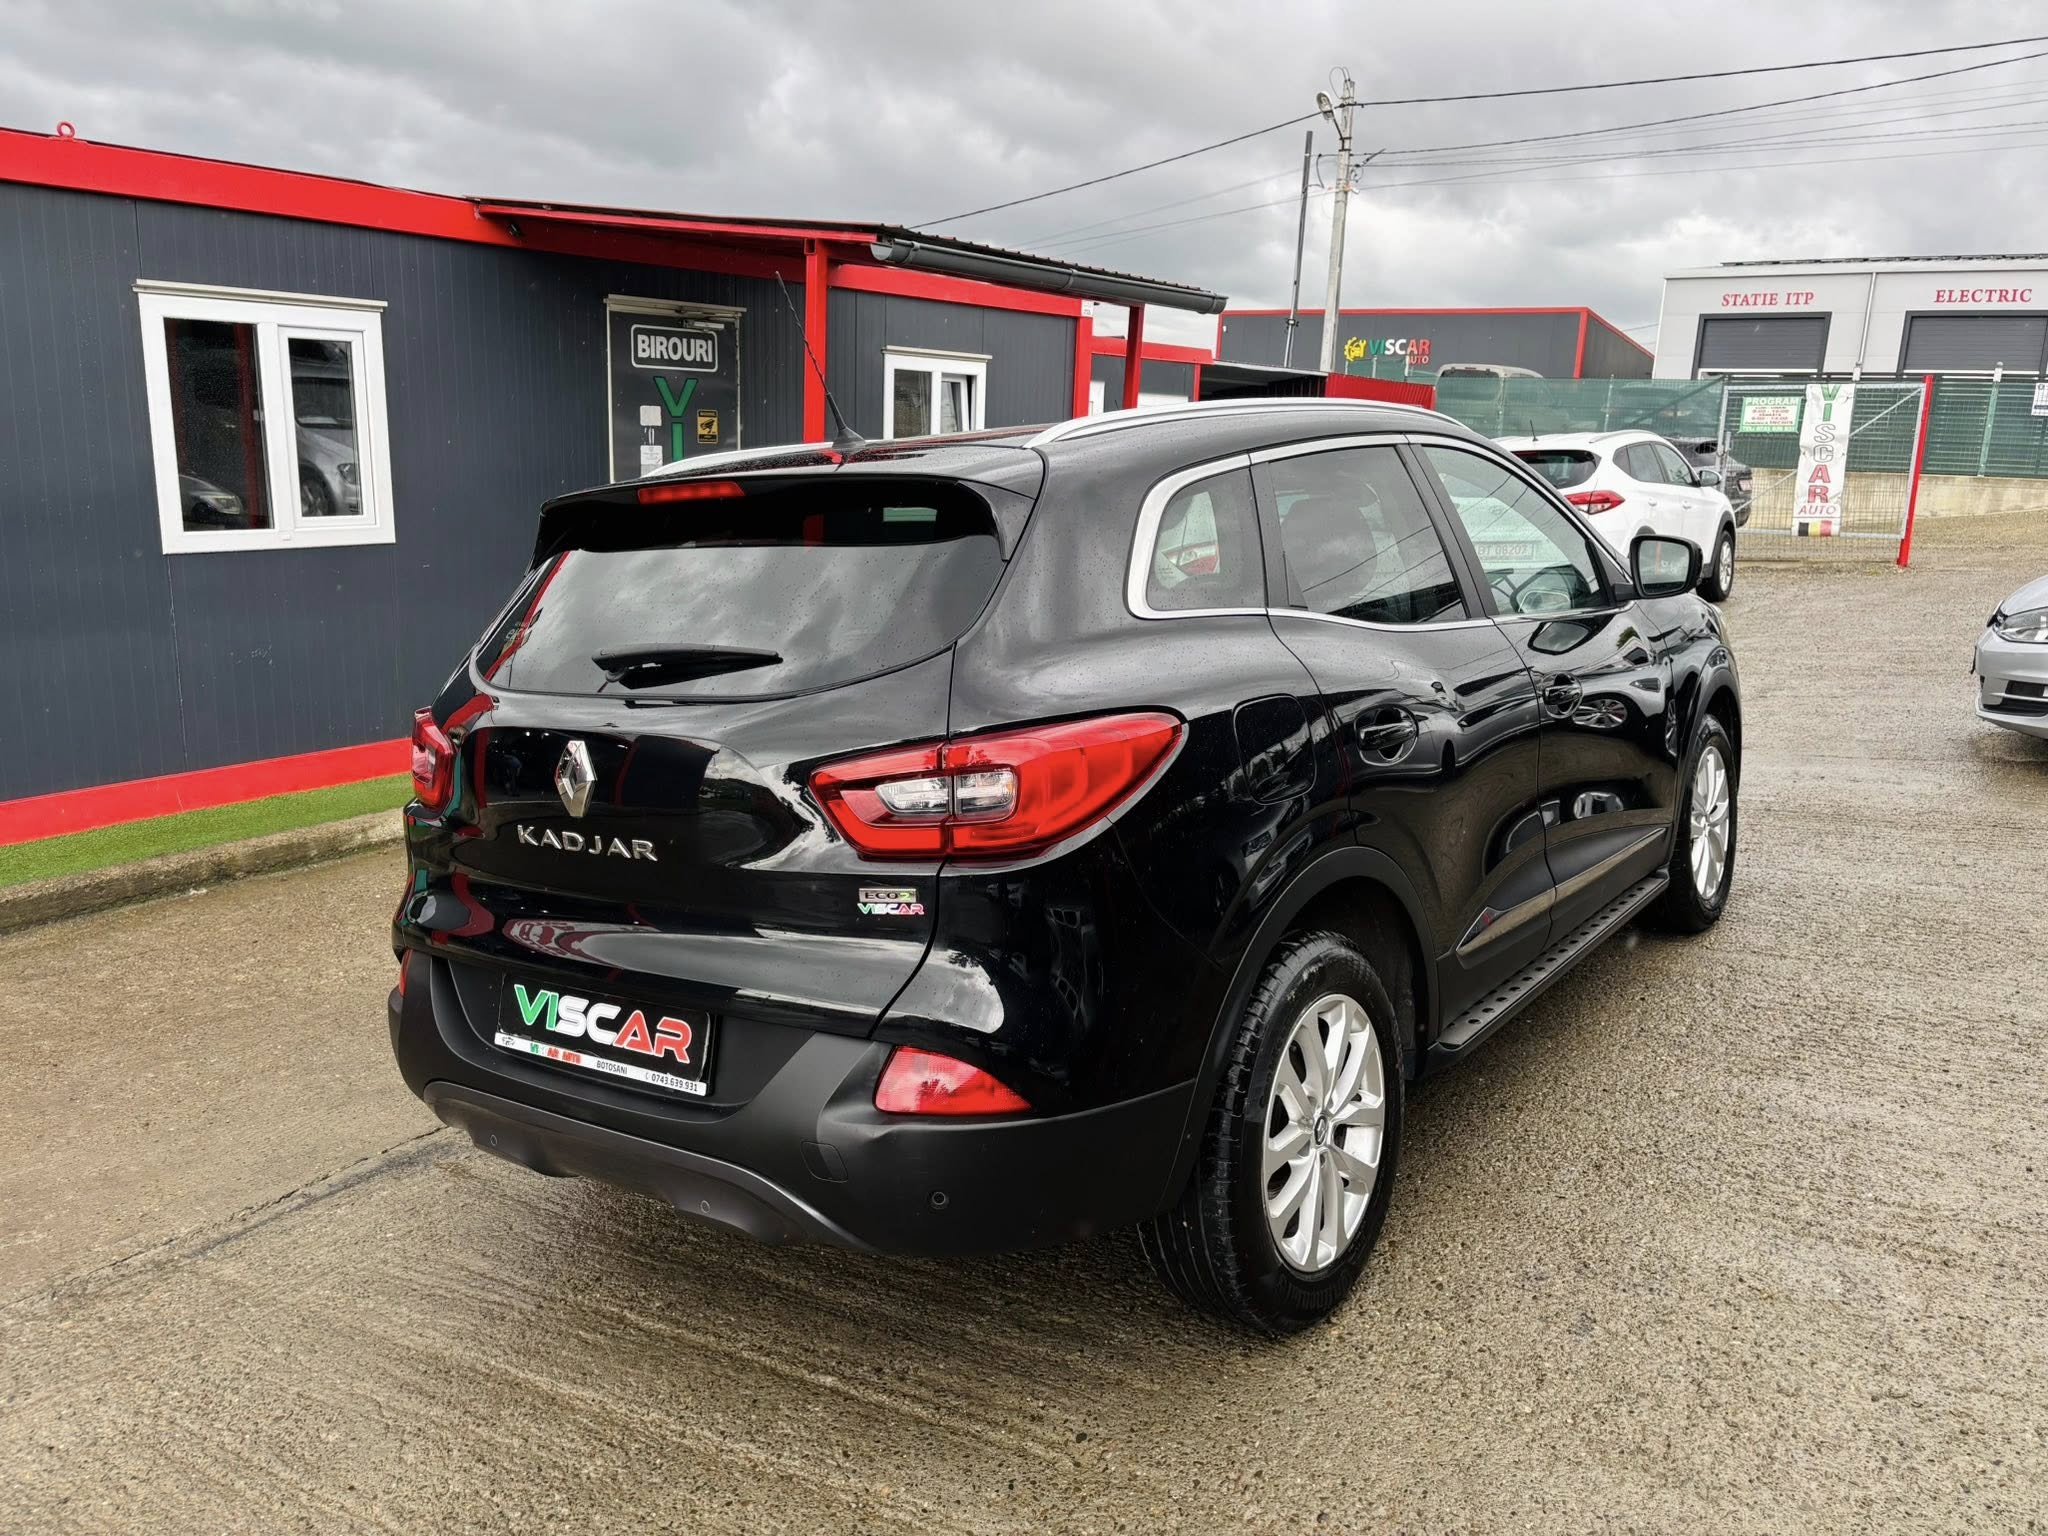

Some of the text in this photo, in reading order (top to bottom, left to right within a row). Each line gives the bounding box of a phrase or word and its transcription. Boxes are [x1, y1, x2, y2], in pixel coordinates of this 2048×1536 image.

[1721, 292, 1815, 307] STATIE ITP
[1934, 288, 2033, 303] ELECTRIC
[637, 334, 713, 363] BIROURI
[1369, 338, 1431, 356] VISCAR
[1746, 397, 1798, 406] PROGRAM
[1807, 384, 1842, 504] VISCAR
[1798, 505, 1837, 516] AUTO
[516, 824, 658, 862] KADJAR
[857, 902, 925, 915] VISCAR
[514, 984, 693, 1065] VISCAR
[596, 1061, 629, 1076] BOTOSANI
[651, 1073, 699, 1093] 0743.639.931
